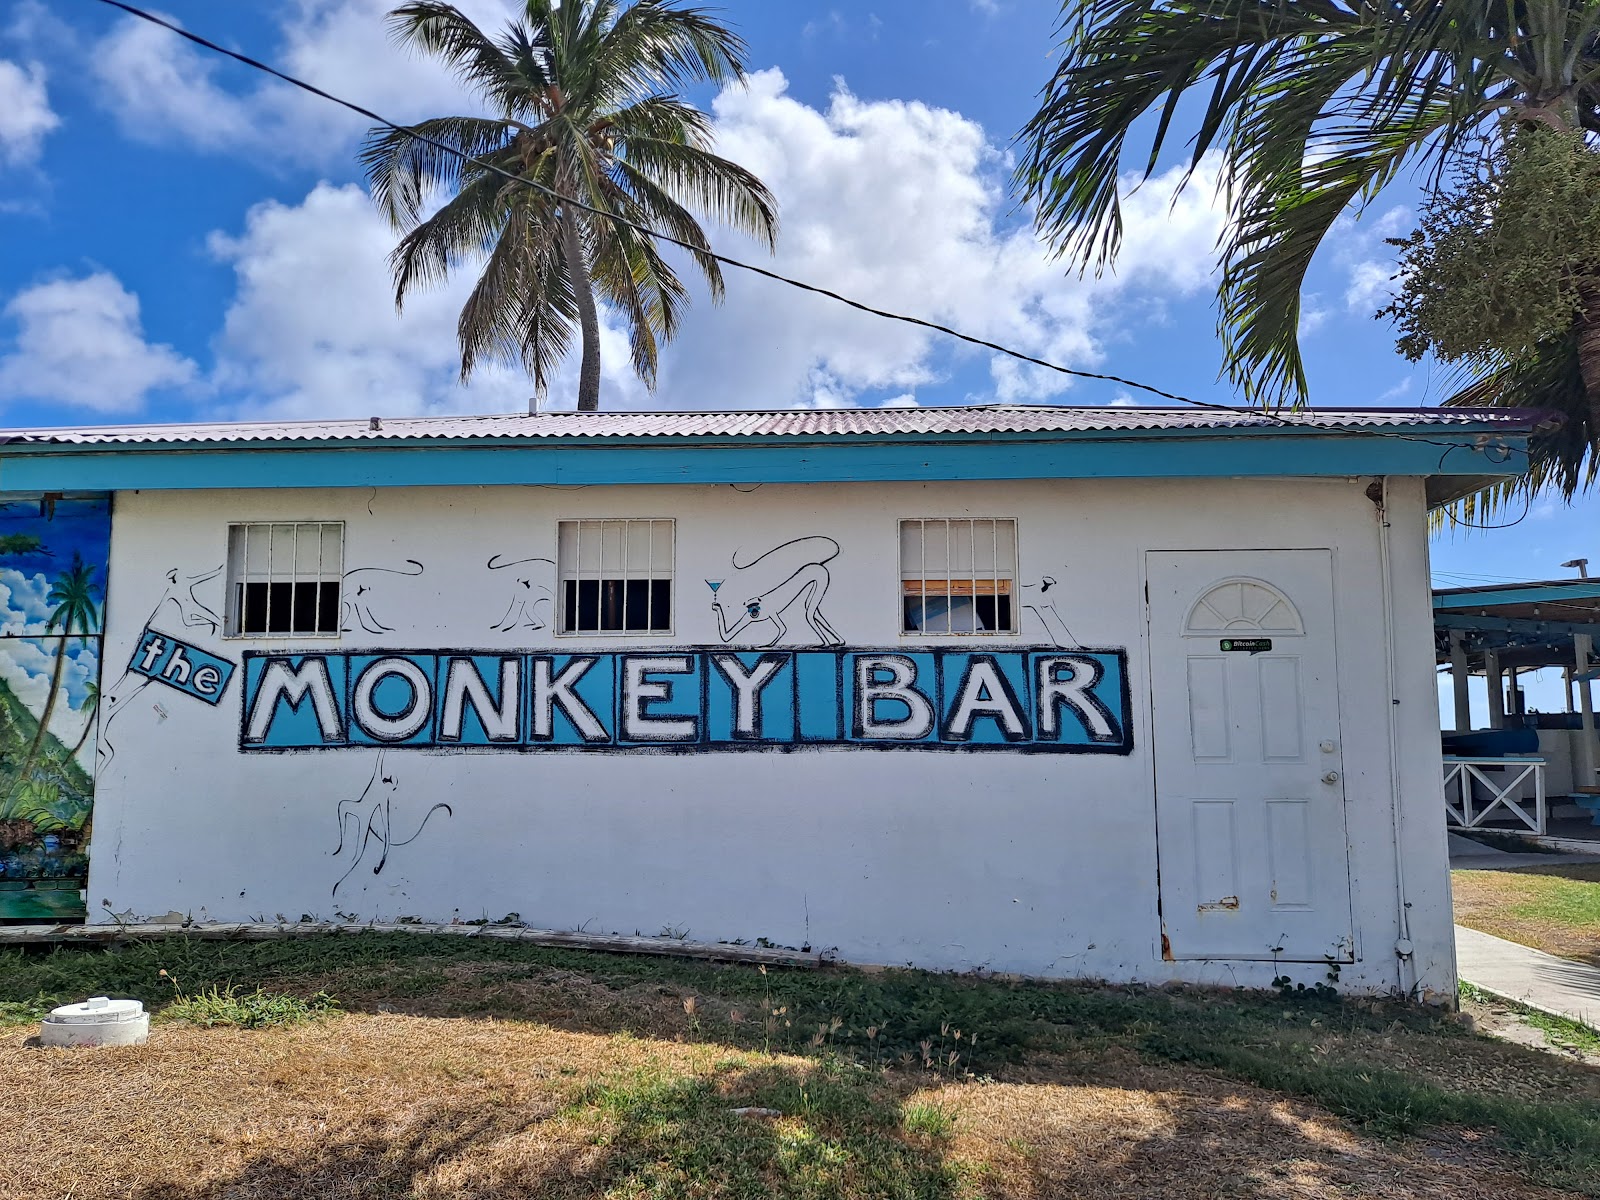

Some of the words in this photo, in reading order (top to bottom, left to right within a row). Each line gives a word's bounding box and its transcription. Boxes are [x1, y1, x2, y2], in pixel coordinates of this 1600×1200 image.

[140, 637, 220, 695] the
[247, 655, 791, 742] MONKEY
[853, 654, 1116, 742] BAR
